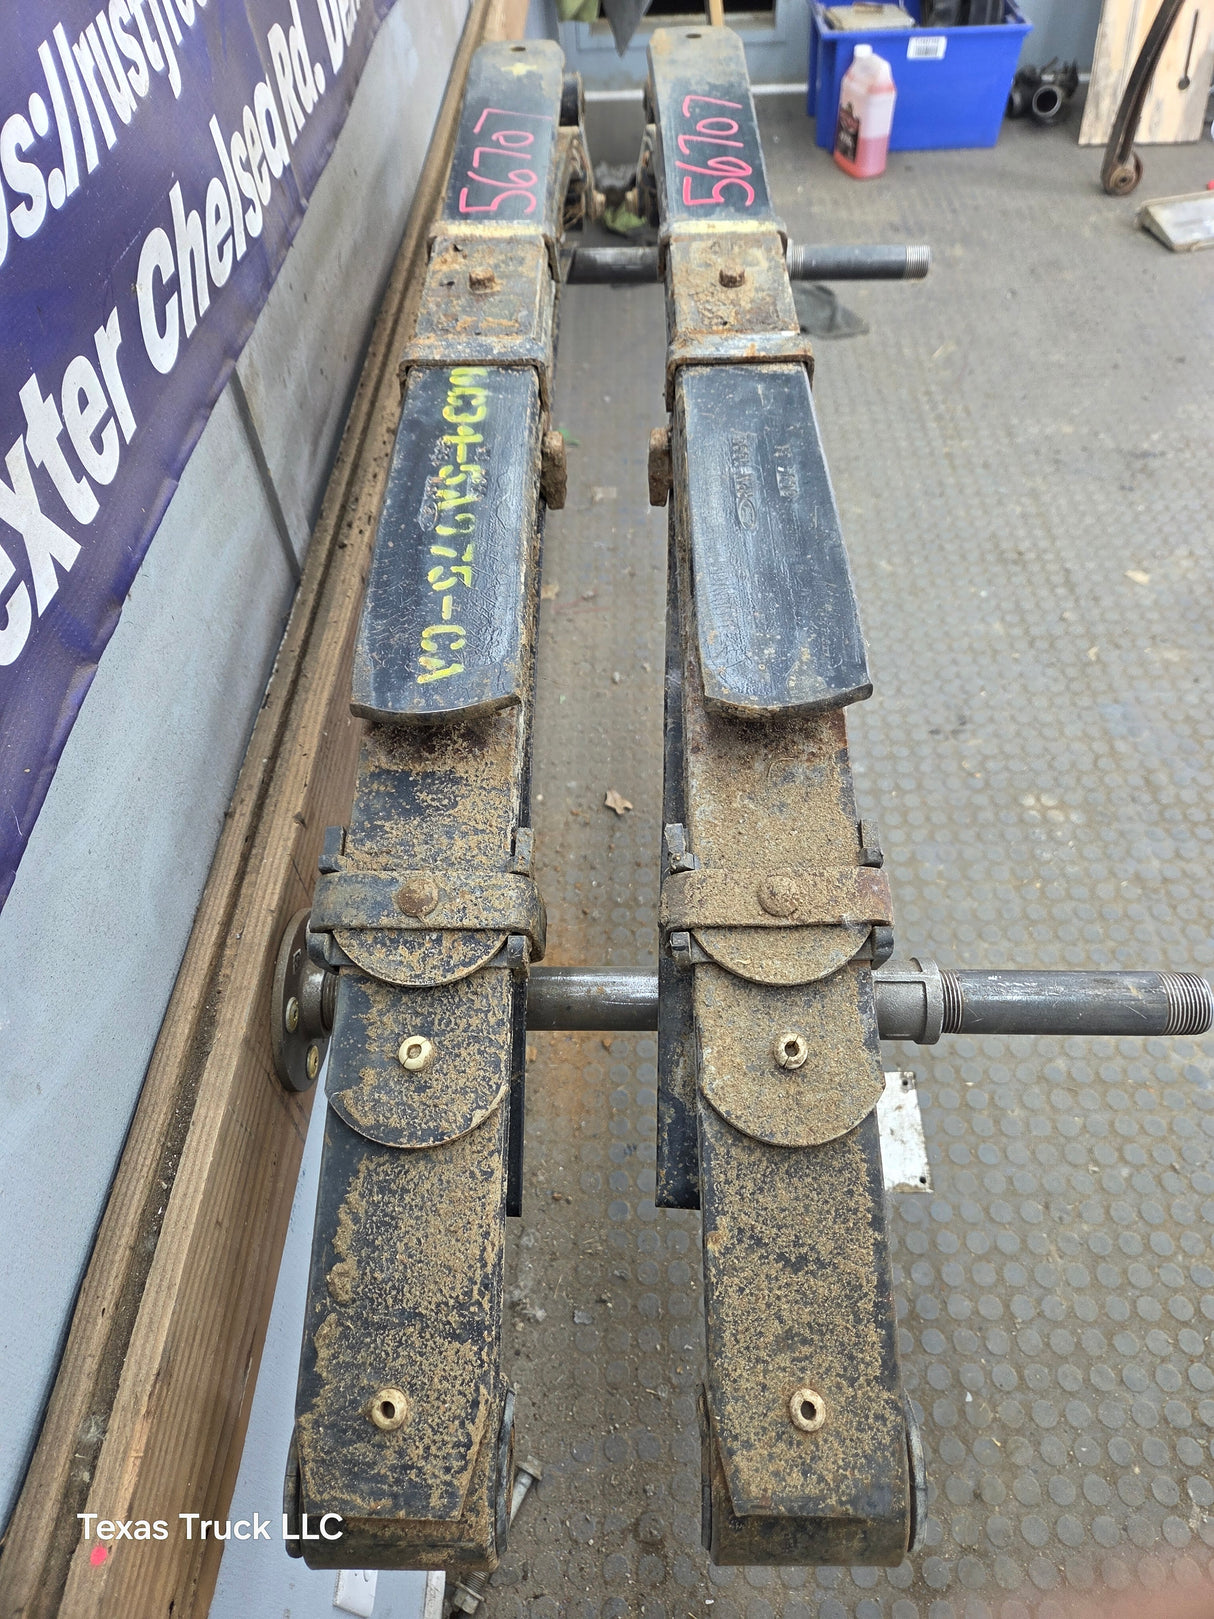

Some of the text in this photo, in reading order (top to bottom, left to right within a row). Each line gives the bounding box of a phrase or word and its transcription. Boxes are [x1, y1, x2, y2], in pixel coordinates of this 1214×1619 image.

[136, 72, 291, 375] Chelsea
[267, 0, 326, 146] Rd.
[316, 0, 361, 75] De
[459, 108, 552, 214] 56707
[676, 95, 754, 207] 56707
